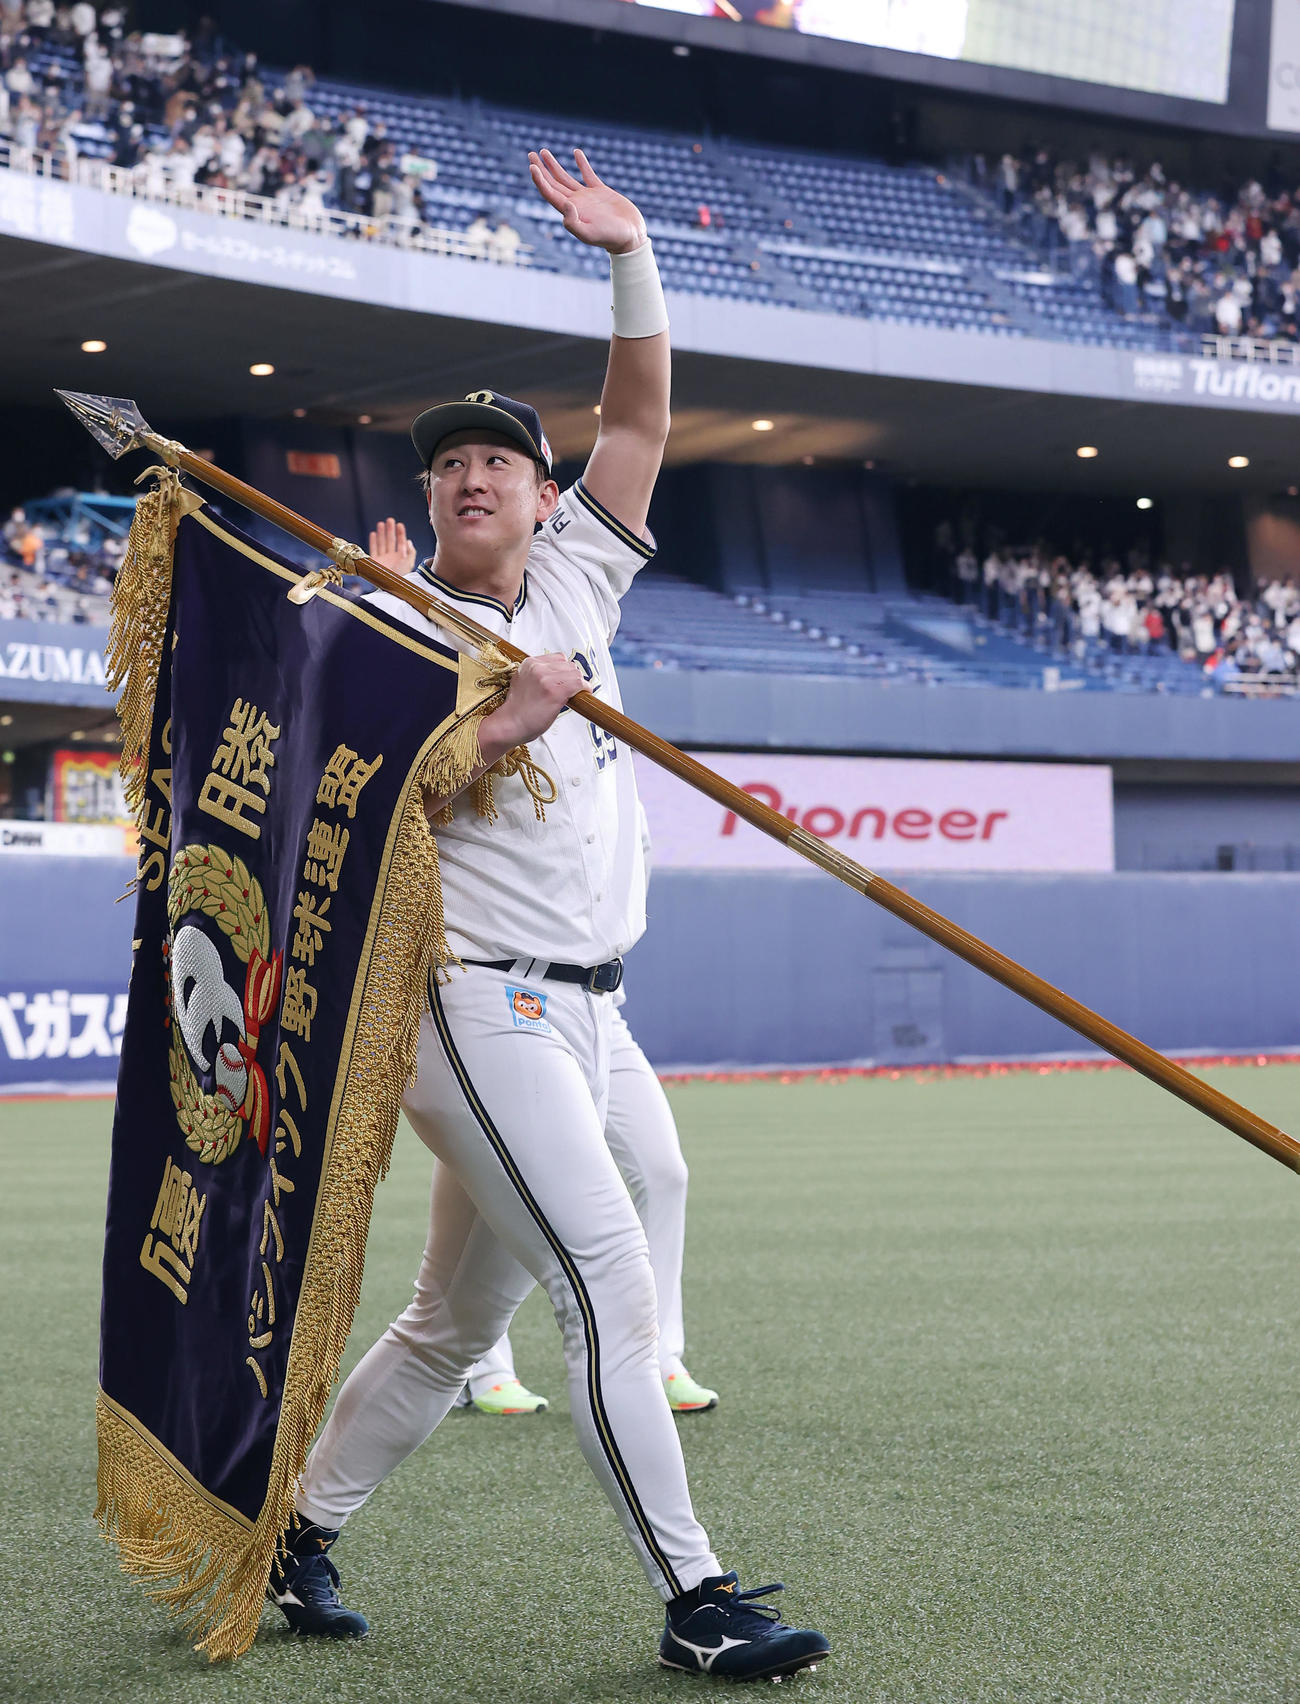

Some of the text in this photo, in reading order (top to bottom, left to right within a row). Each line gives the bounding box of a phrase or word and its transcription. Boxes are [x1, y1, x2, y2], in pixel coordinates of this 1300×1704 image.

[246, 743, 384, 1399] パシフィック野球連盟
